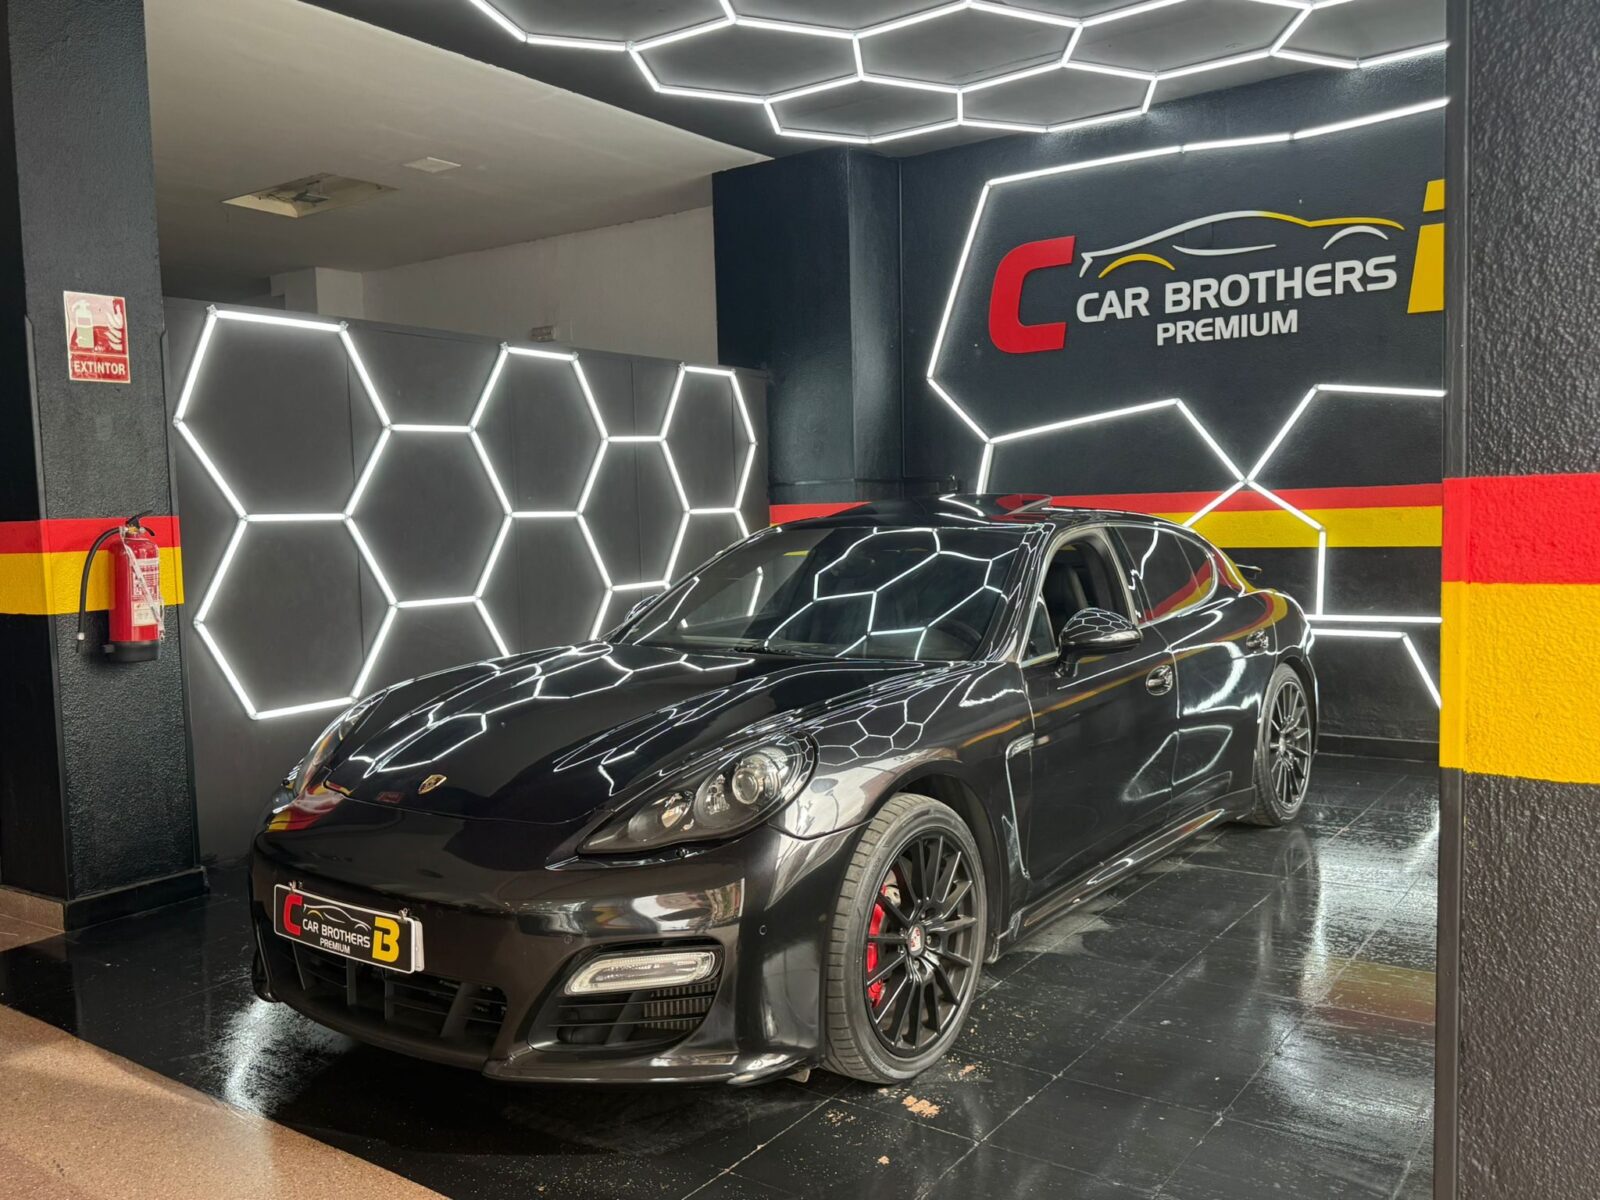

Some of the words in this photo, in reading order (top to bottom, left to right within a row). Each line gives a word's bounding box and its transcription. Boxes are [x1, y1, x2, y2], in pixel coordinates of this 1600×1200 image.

[988, 235, 1076, 354] C
[1076, 286, 1150, 323] CAR
[1165, 254, 1397, 314] BROTHERS
[1156, 309, 1298, 346] PREMIUM
[73, 360, 126, 376] EXTINTOR
[283, 894, 303, 936] C
[302, 918, 319, 934] CAR
[321, 924, 371, 948] BROTHERS
[319, 937, 350, 954] PREMIUM
[372, 916, 400, 963] B
